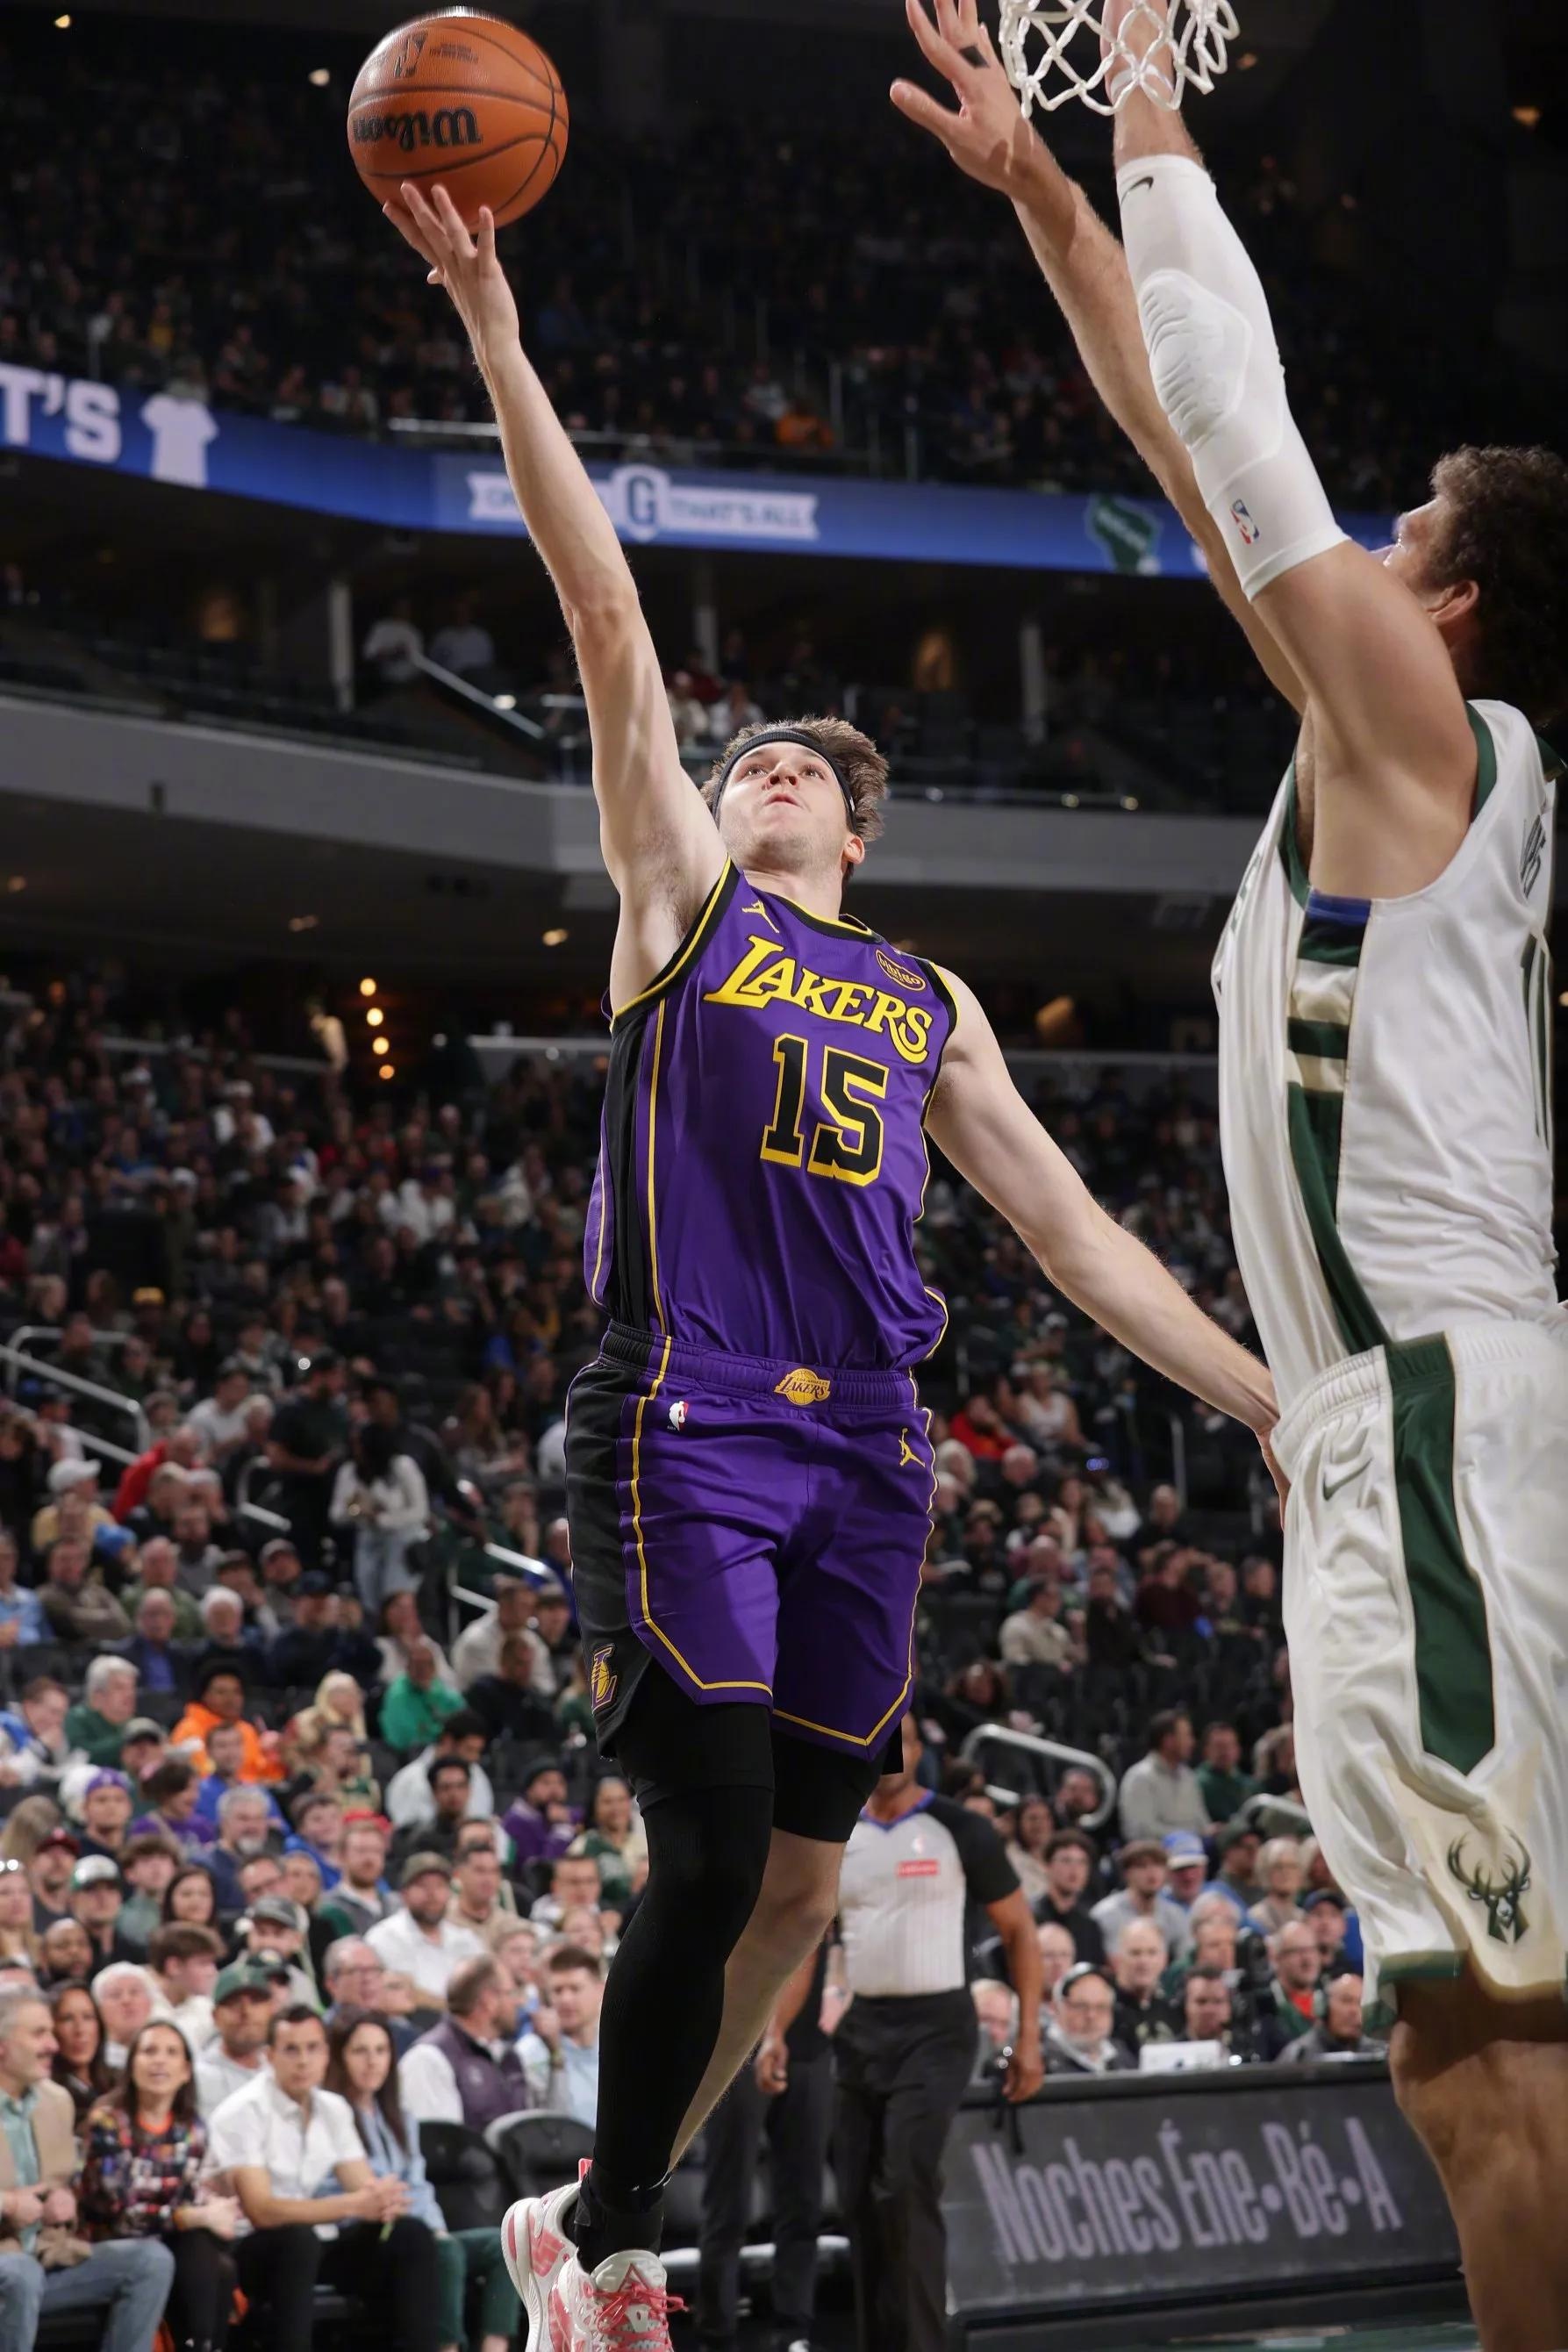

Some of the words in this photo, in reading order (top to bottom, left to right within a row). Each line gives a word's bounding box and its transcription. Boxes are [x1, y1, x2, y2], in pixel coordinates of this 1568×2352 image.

[626, 474, 657, 527] G
[703, 934, 934, 1065] LAKERS
[759, 1032, 890, 1187] 15
[777, 1374, 829, 1401] LAKERS
[971, 2136, 1181, 2263] Noches
